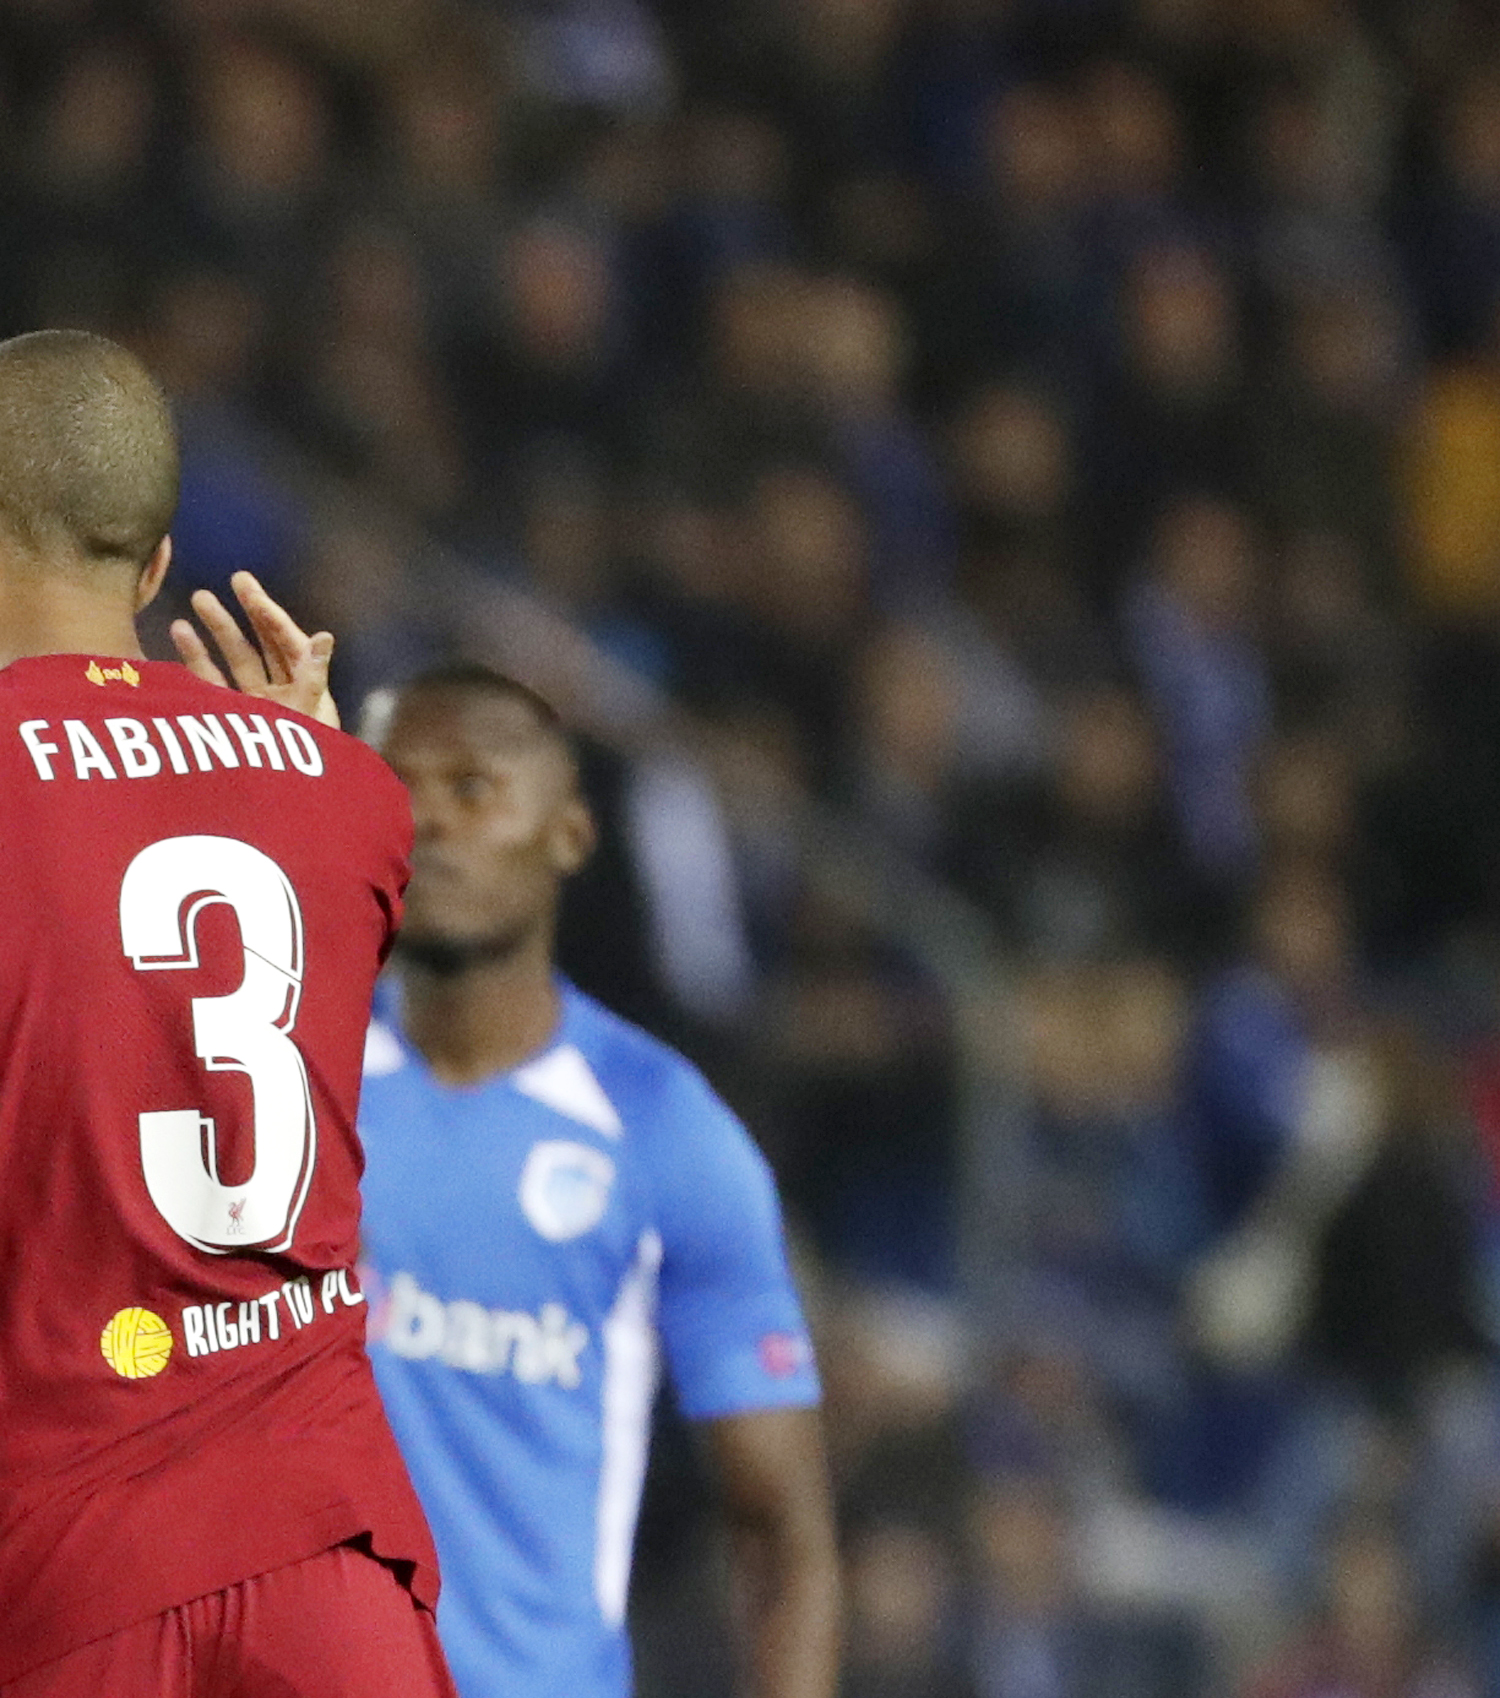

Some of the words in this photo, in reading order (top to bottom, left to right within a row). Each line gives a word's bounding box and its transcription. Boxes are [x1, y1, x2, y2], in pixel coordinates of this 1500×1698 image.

[18, 713, 326, 781] FABINHO
[119, 835, 317, 1255] 3
[182, 1290, 281, 1357] RIGHT
[321, 1268, 364, 1315] PL
